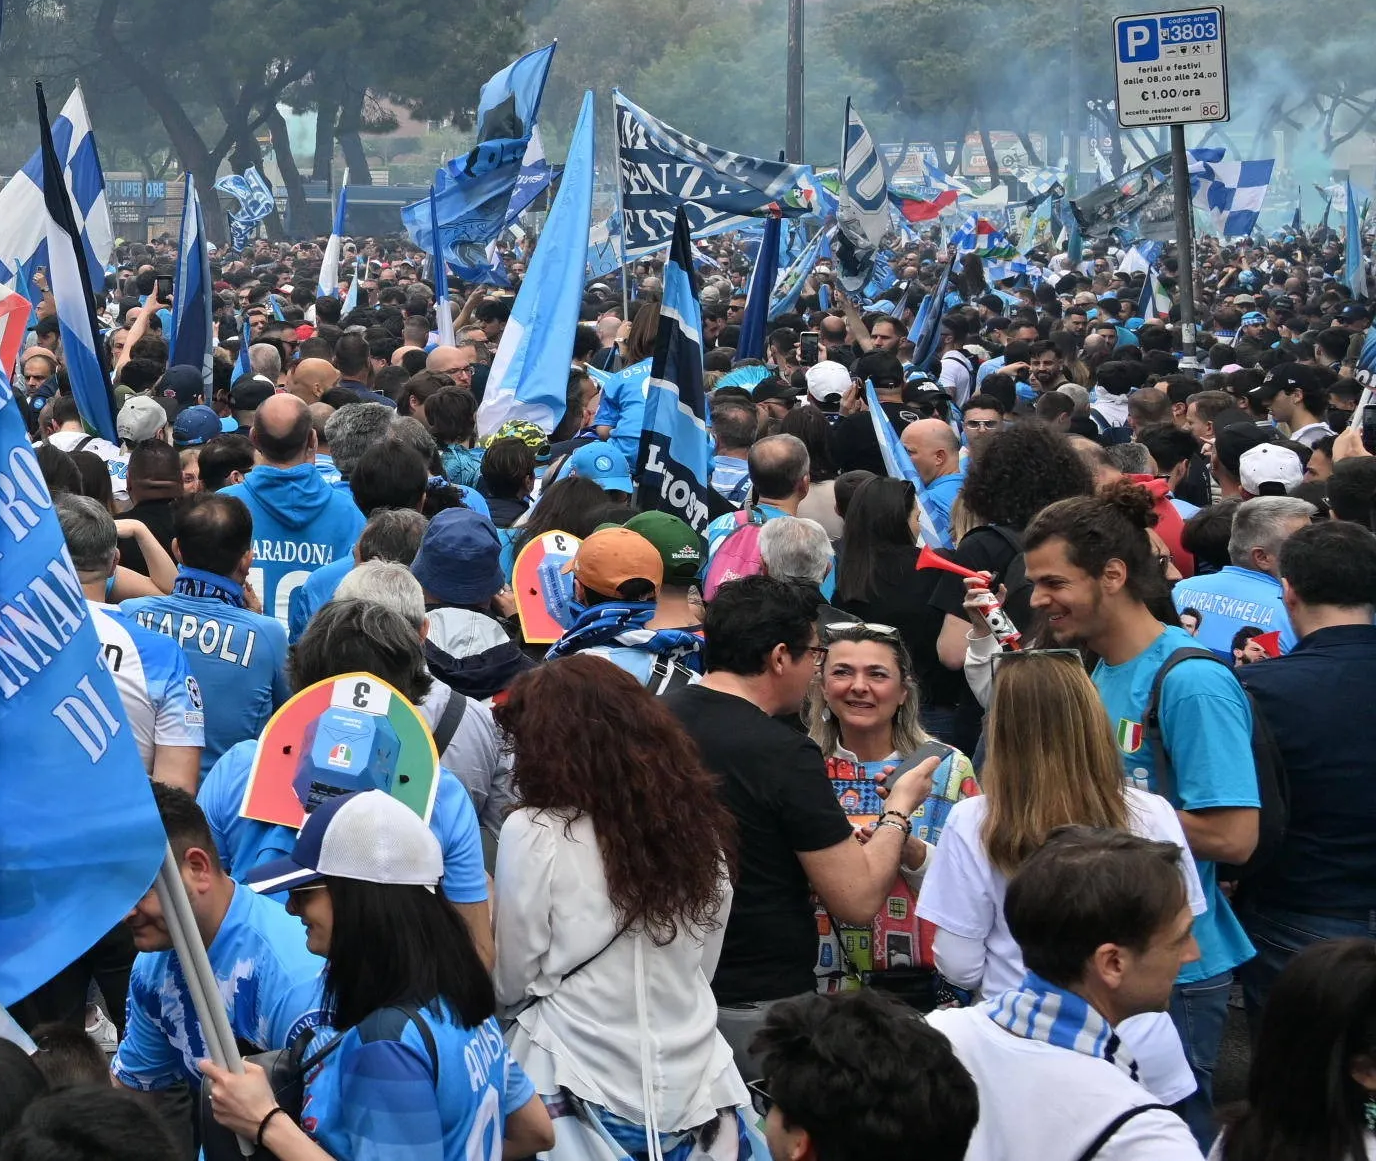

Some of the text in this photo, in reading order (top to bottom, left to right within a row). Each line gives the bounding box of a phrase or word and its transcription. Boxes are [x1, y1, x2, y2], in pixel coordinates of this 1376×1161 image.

[1168, 17, 1191, 25] codice
[1171, 23, 1216, 41] 3803
[1127, 26, 1150, 57] P
[1138, 65, 1163, 74] feriali
[1174, 62, 1201, 70] festivi
[1123, 77, 1144, 85] dalle
[1147, 75, 1172, 83] 08.00
[1193, 71, 1218, 79] 24.00
[1152, 106, 1180, 114] residenti
[1202, 105, 1219, 116] 8C
[251, 539, 333, 567] ARADONA
[1176, 588, 1275, 627] KVARATSKHELIA
[352, 681, 371, 708] 3
[52, 674, 122, 765] DI
